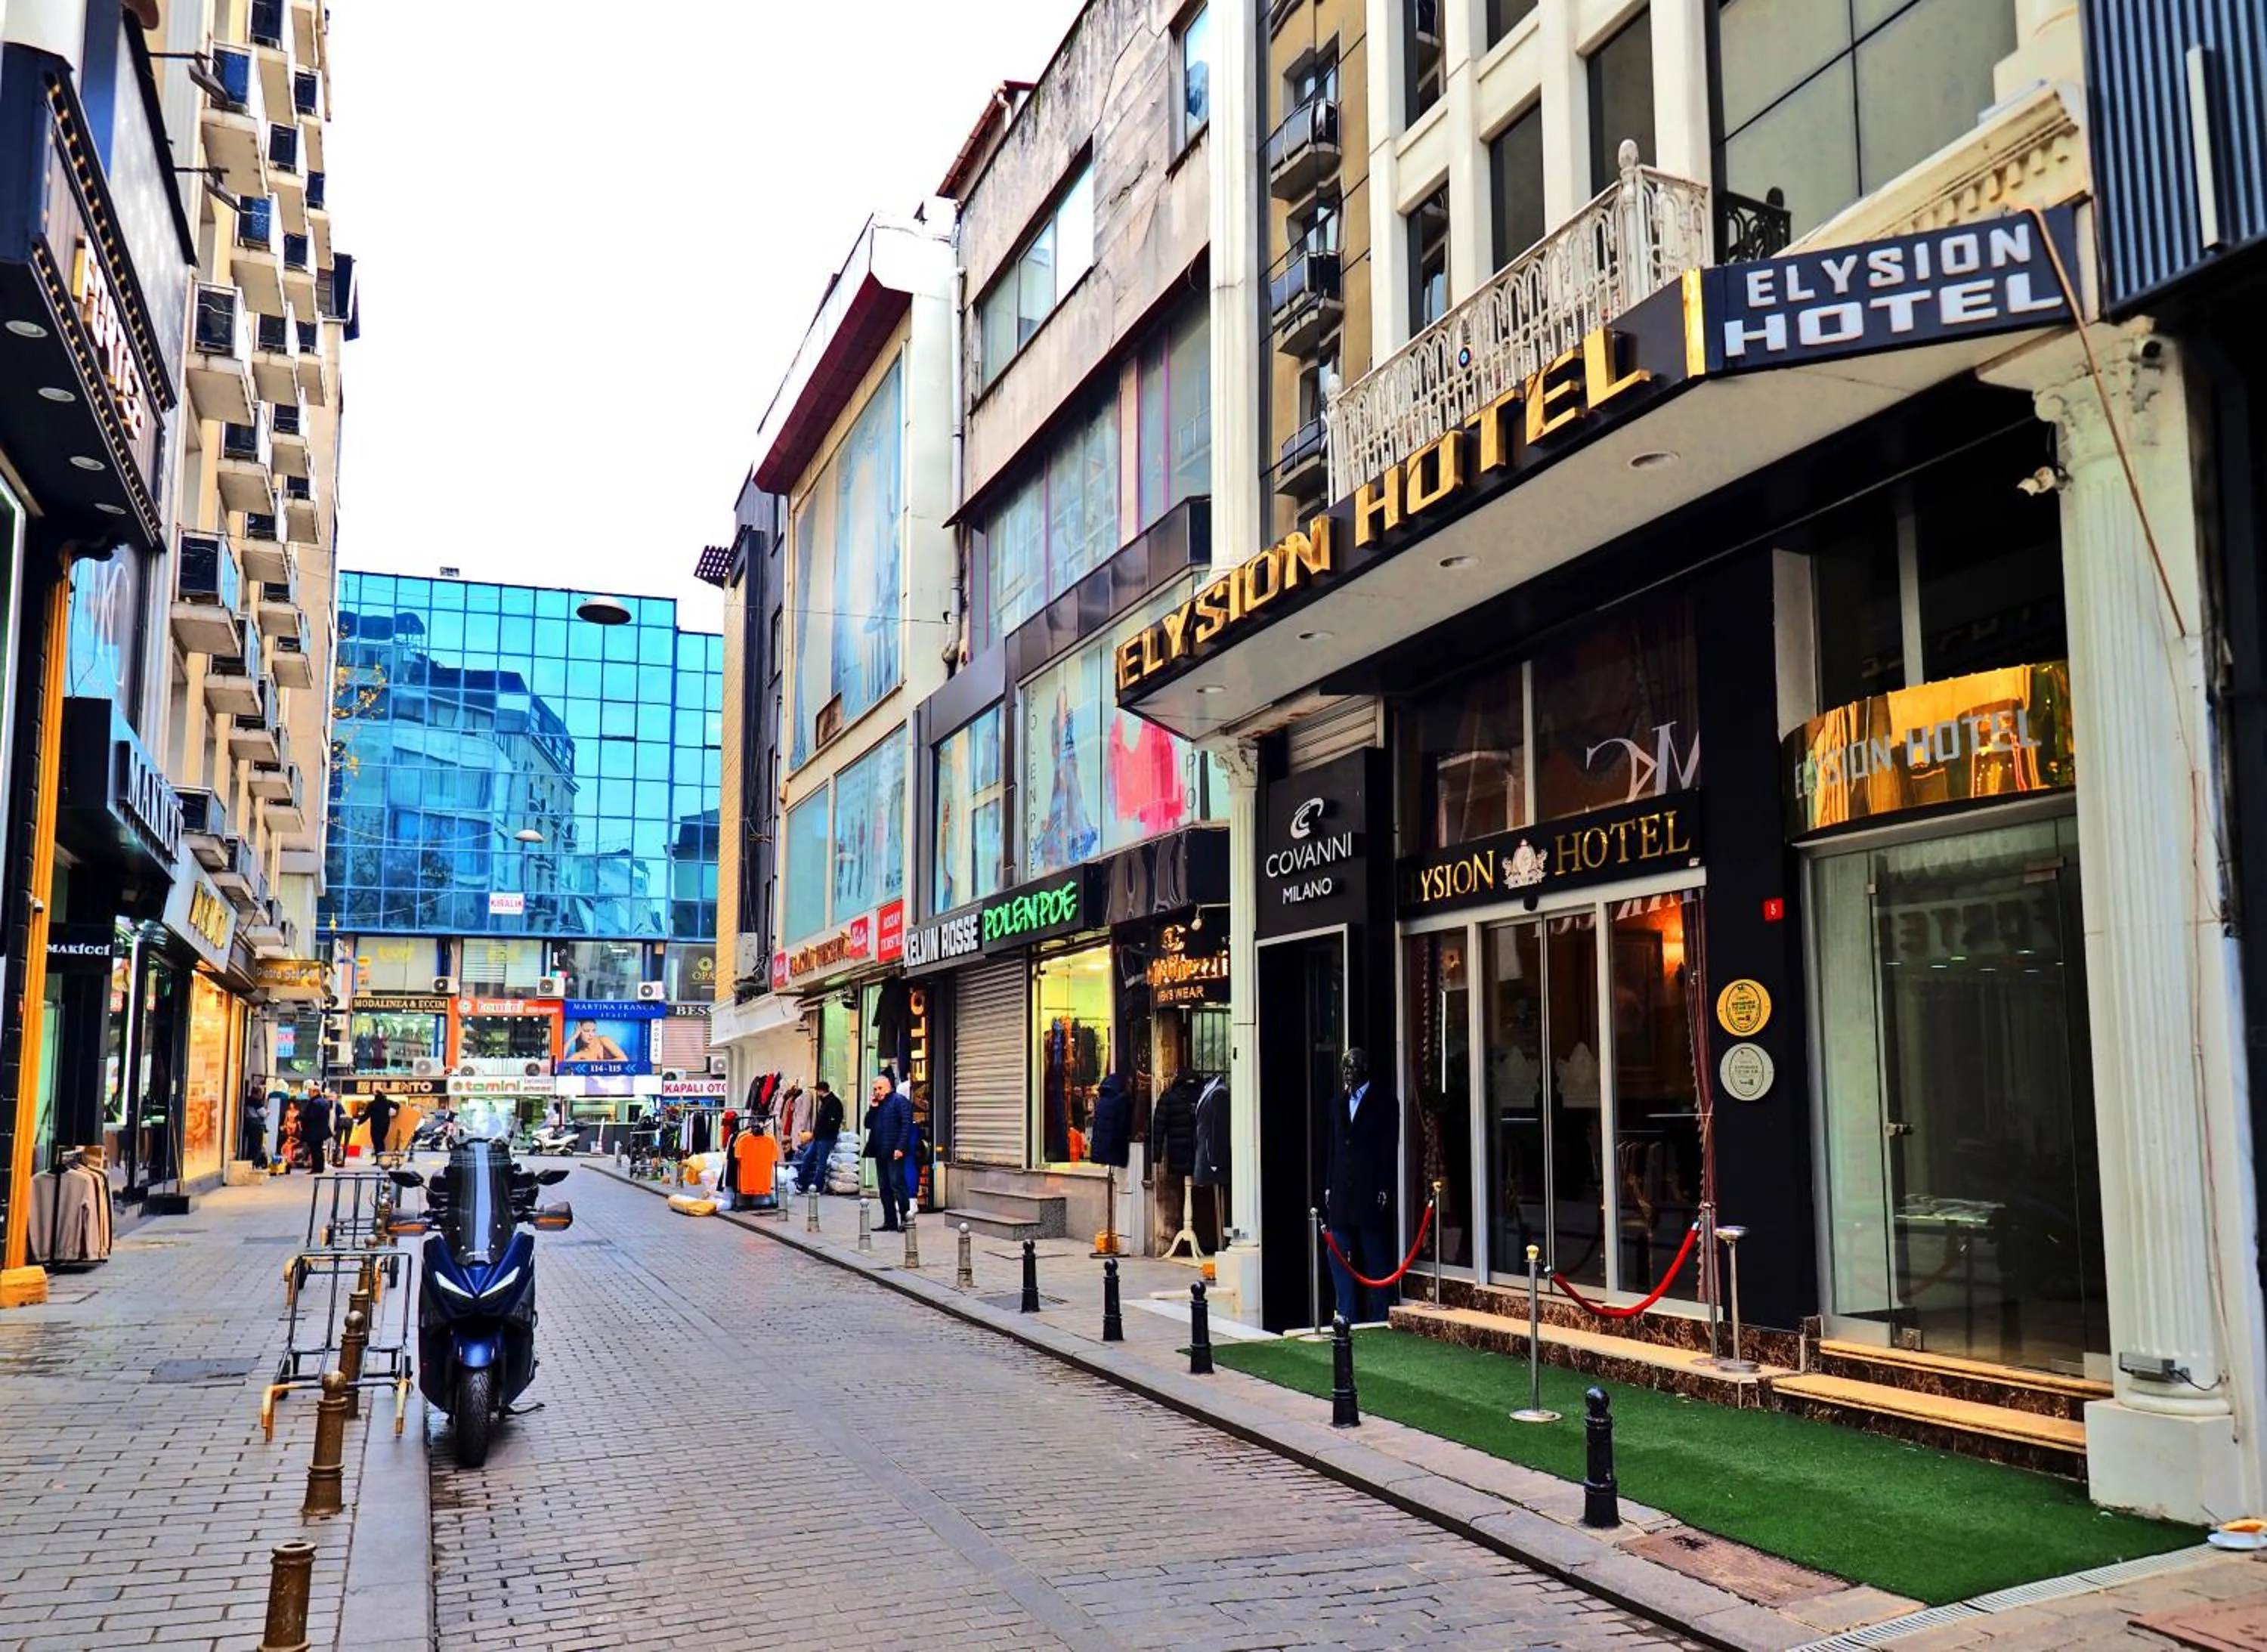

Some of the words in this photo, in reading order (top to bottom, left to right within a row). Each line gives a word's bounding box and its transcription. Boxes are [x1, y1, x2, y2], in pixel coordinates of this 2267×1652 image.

[1747, 224, 2031, 308] ELYSION
[1724, 272, 2064, 357] HOTEL
[1116, 515, 1331, 689] ELYSION
[1355, 325, 1650, 547] HOTEL
[1906, 707, 2043, 767] HOTEL
[1265, 831, 1352, 877] COVANNI
[1403, 849, 1495, 905] YSION
[1554, 810, 1691, 876] HOTEL
[983, 880, 1078, 942] POLENPOE
[1282, 877, 1333, 905] MILANO
[904, 925, 939, 968] KELVIN
[942, 914, 979, 959] ROSSE
[619, 1003, 656, 1011] FRANCA
[1174, 985, 1205, 1000] WEAR
[590, 1064, 622, 1072] 114-115
[664, 1083, 704, 1094] KAPALI
